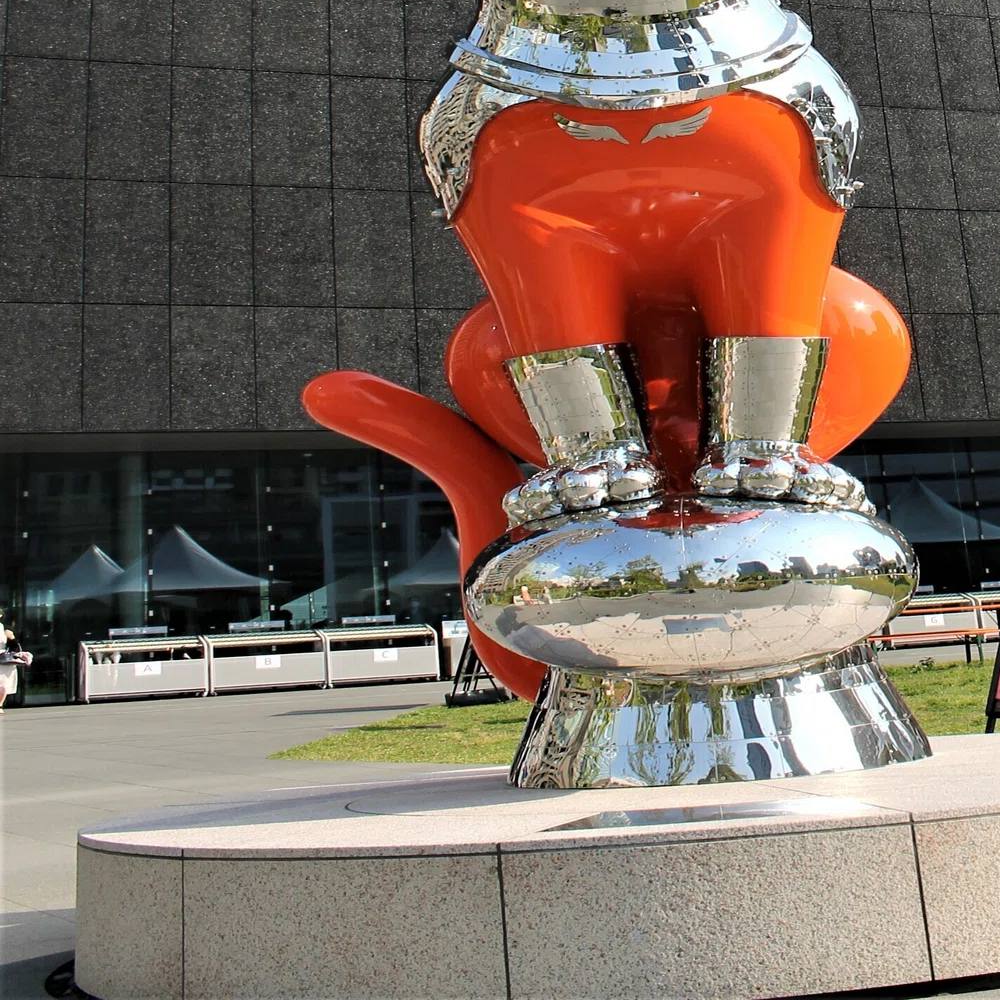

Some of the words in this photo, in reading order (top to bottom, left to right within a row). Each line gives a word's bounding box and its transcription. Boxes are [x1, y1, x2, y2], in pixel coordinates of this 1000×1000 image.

[381, 650, 389, 659] C
[264, 657, 272, 666] B
[143, 664, 153, 672] A
